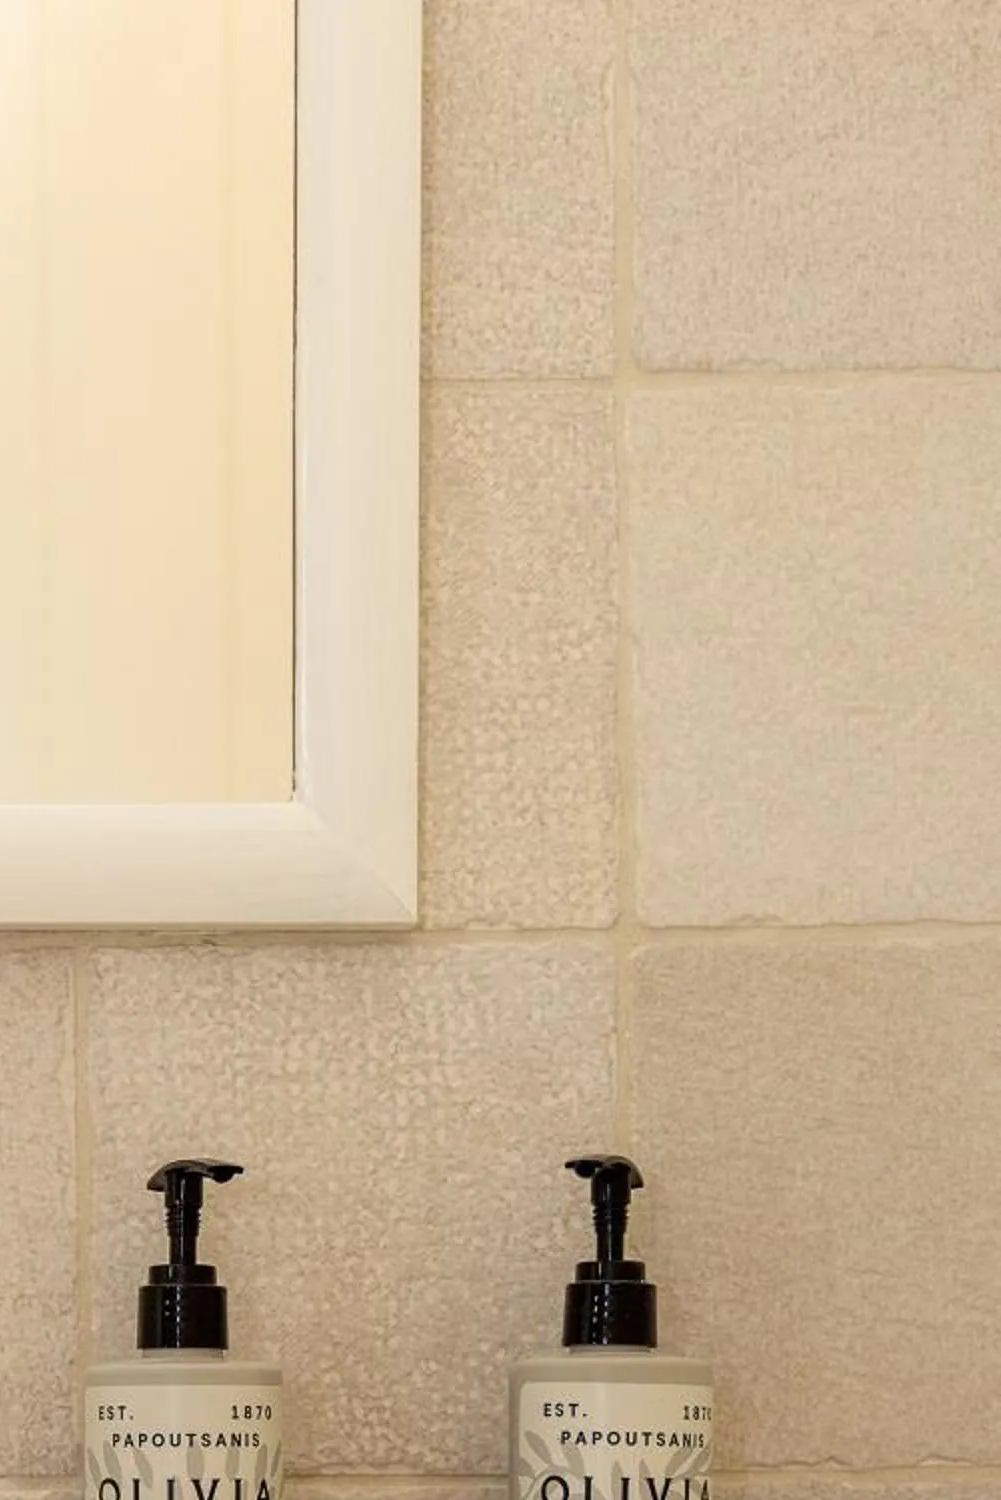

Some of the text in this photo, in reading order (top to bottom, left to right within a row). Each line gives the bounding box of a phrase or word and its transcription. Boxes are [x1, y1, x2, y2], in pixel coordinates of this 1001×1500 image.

[98, 1405, 272, 1421] EST. 1870
[542, 1403, 587, 1417] EST.
[112, 1433, 260, 1448] PAPOUTSANIS
[560, 1431, 704, 1448] PAPOUTSANIS
